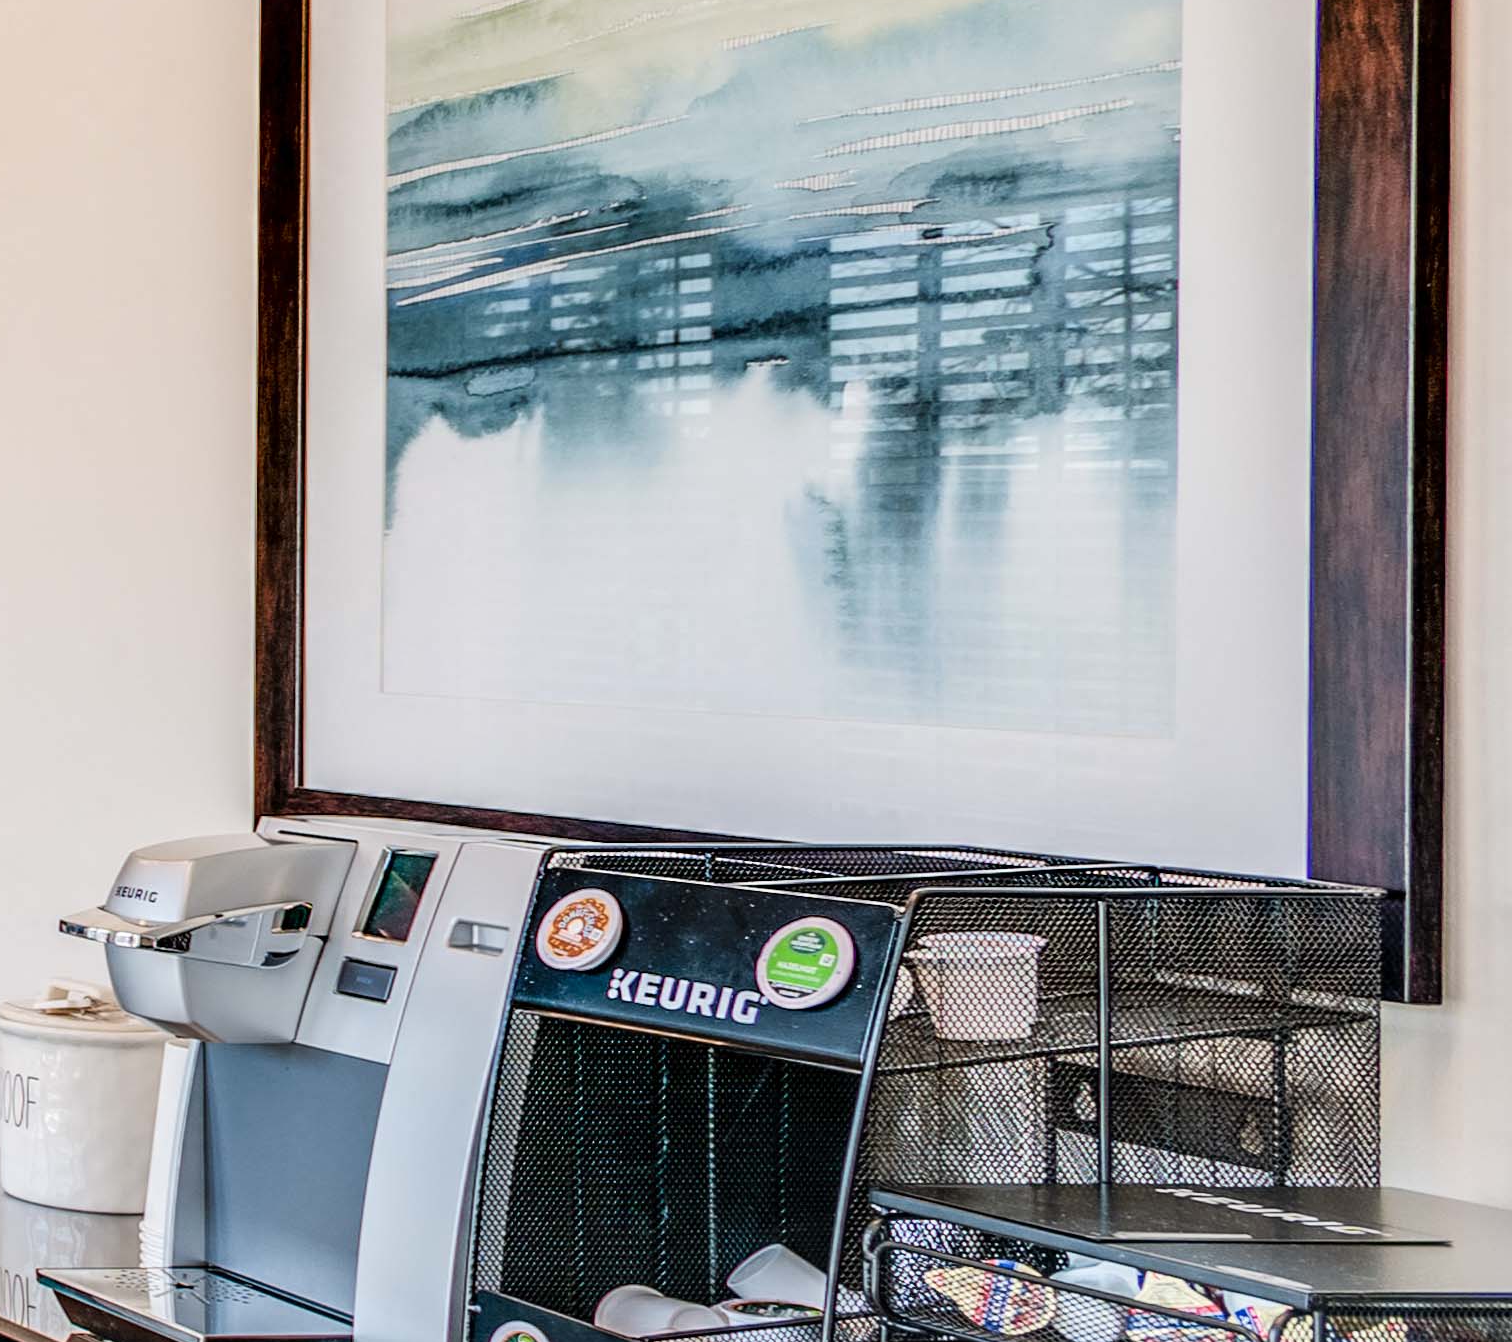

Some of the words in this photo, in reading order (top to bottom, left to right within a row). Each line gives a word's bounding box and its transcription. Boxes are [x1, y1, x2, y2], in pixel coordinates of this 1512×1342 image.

[115, 885, 159, 903] KEURIG
[607, 968, 762, 1025] KEURIG
[0, 1067, 40, 1129] OOF
[1155, 1188, 1392, 1237] KEURIG
